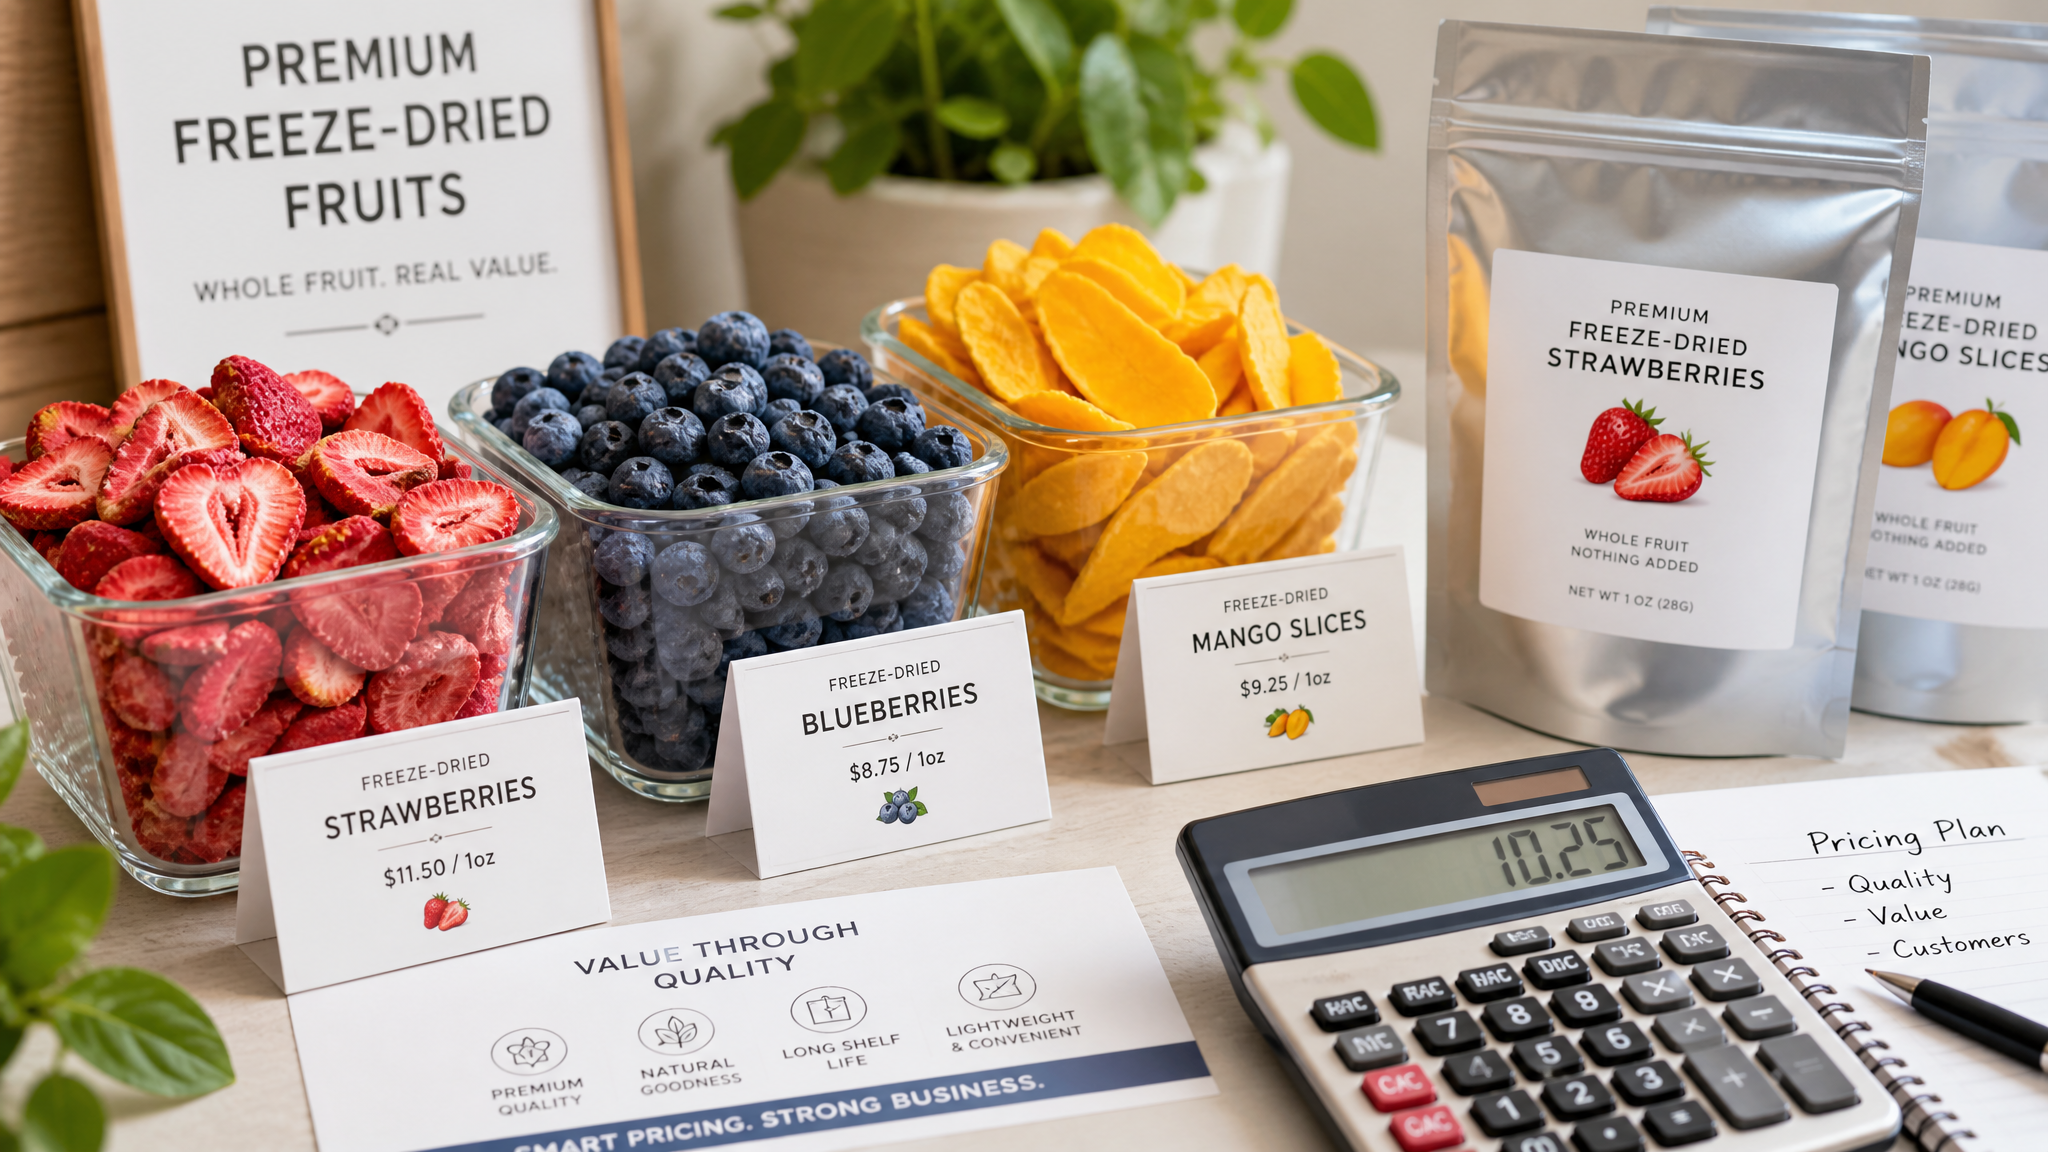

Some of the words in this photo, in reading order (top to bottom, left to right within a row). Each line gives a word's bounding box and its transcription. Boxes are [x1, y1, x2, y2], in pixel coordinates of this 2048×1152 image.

[242, 32, 477, 87] PREMIUM
[174, 94, 550, 164] FREEZE-DRIED
[286, 172, 466, 228] FRUITS
[194, 274, 294, 302] WHOLE
[306, 266, 386, 293] FRUIT.
[397, 261, 460, 286] REAL
[470, 252, 558, 279] VALUE.
[1611, 300, 1709, 324] PREMIUM
[1907, 286, 2001, 309] PREMIUM
[1569, 321, 1747, 356] FREEZE-DRIED
[1901, 311, 2037, 340] EZE-DRIED
[1547, 348, 1765, 389] STRAWBERRIES
[1959, 346, 2048, 373] SLICES
[1875, 512, 1929, 530] WHOLE
[1935, 519, 1978, 535] FRUIT
[1584, 528, 1639, 547] WHOLE
[1645, 537, 1689, 552] FRUIT
[1871, 529, 1929, 549] OTHING
[1935, 539, 1987, 555] ADDED
[1571, 546, 1640, 566] NOTHING
[1645, 557, 1699, 573] ADDED
[1888, 570, 1909, 584] WT
[1913, 574, 1919, 586] 1
[1922, 575, 1942, 589] OZ
[1945, 579, 1980, 595] (28G)
[1223, 587, 1328, 613] FREEZE-DRIED
[1568, 585, 1595, 598] NET
[1599, 590, 1620, 602] WT
[1624, 594, 1630, 604] 1
[1634, 595, 1653, 607] OZ
[1657, 598, 1694, 614] (28G)
[1192, 622, 1282, 653] MANGO
[1290, 609, 1366, 639] SLICES
[829, 660, 941, 691] FREEZE-DRIED
[1240, 675, 1288, 698] $9.25
[1293, 672, 1300, 691] /
[1305, 671, 1331, 687] 1oz
[802, 682, 978, 735] BLUEBERRIES
[361, 753, 491, 790] FREEZE-DRIED
[849, 756, 900, 782] $8.75
[906, 752, 912, 771] /
[917, 751, 946, 767] 1oz
[325, 776, 537, 839] STRAWBERRIES
[1807, 830, 1922, 855] Pricing
[1933, 818, 2006, 842] Plan
[1492, 816, 1628, 888] 10.25
[384, 858, 446, 889] $11.50
[452, 854, 459, 874] /
[464, 851, 495, 870] 1oz
[1849, 869, 1951, 894] Quality
[1867, 904, 1948, 925] Value
[574, 946, 683, 976] VALUE
[692, 921, 860, 959] THROUGH
[1893, 932, 2031, 958] Customers
[653, 955, 797, 989] QUALITY
[946, 1010, 1076, 1037] LIGHTWEIGHT
[1436, 1018, 1457, 1039] 7
[1506, 1004, 1531, 1024] 8
[782, 1043, 836, 1059] LONG
[842, 1033, 901, 1052] SHELF
[952, 1042, 964, 1052] &
[968, 1025, 1082, 1050] CONVENIENT
[1535, 1041, 1561, 1064] 5
[1605, 1027, 1632, 1049] 6
[640, 1058, 735, 1079] NATURAL
[827, 1055, 868, 1070] LIFE
[491, 1078, 583, 1100] PREMIUM
[640, 1073, 742, 1095] GOODNESS
[1496, 1096, 1520, 1120] 1
[1565, 1081, 1595, 1105] 2
[1635, 1066, 1664, 1090] 3
[499, 1095, 582, 1116] QUALITY
[627, 1115, 753, 1148] PRICING.
[761, 1096, 882, 1128] STRONG
[891, 1074, 1045, 1110] BUSINESS.
